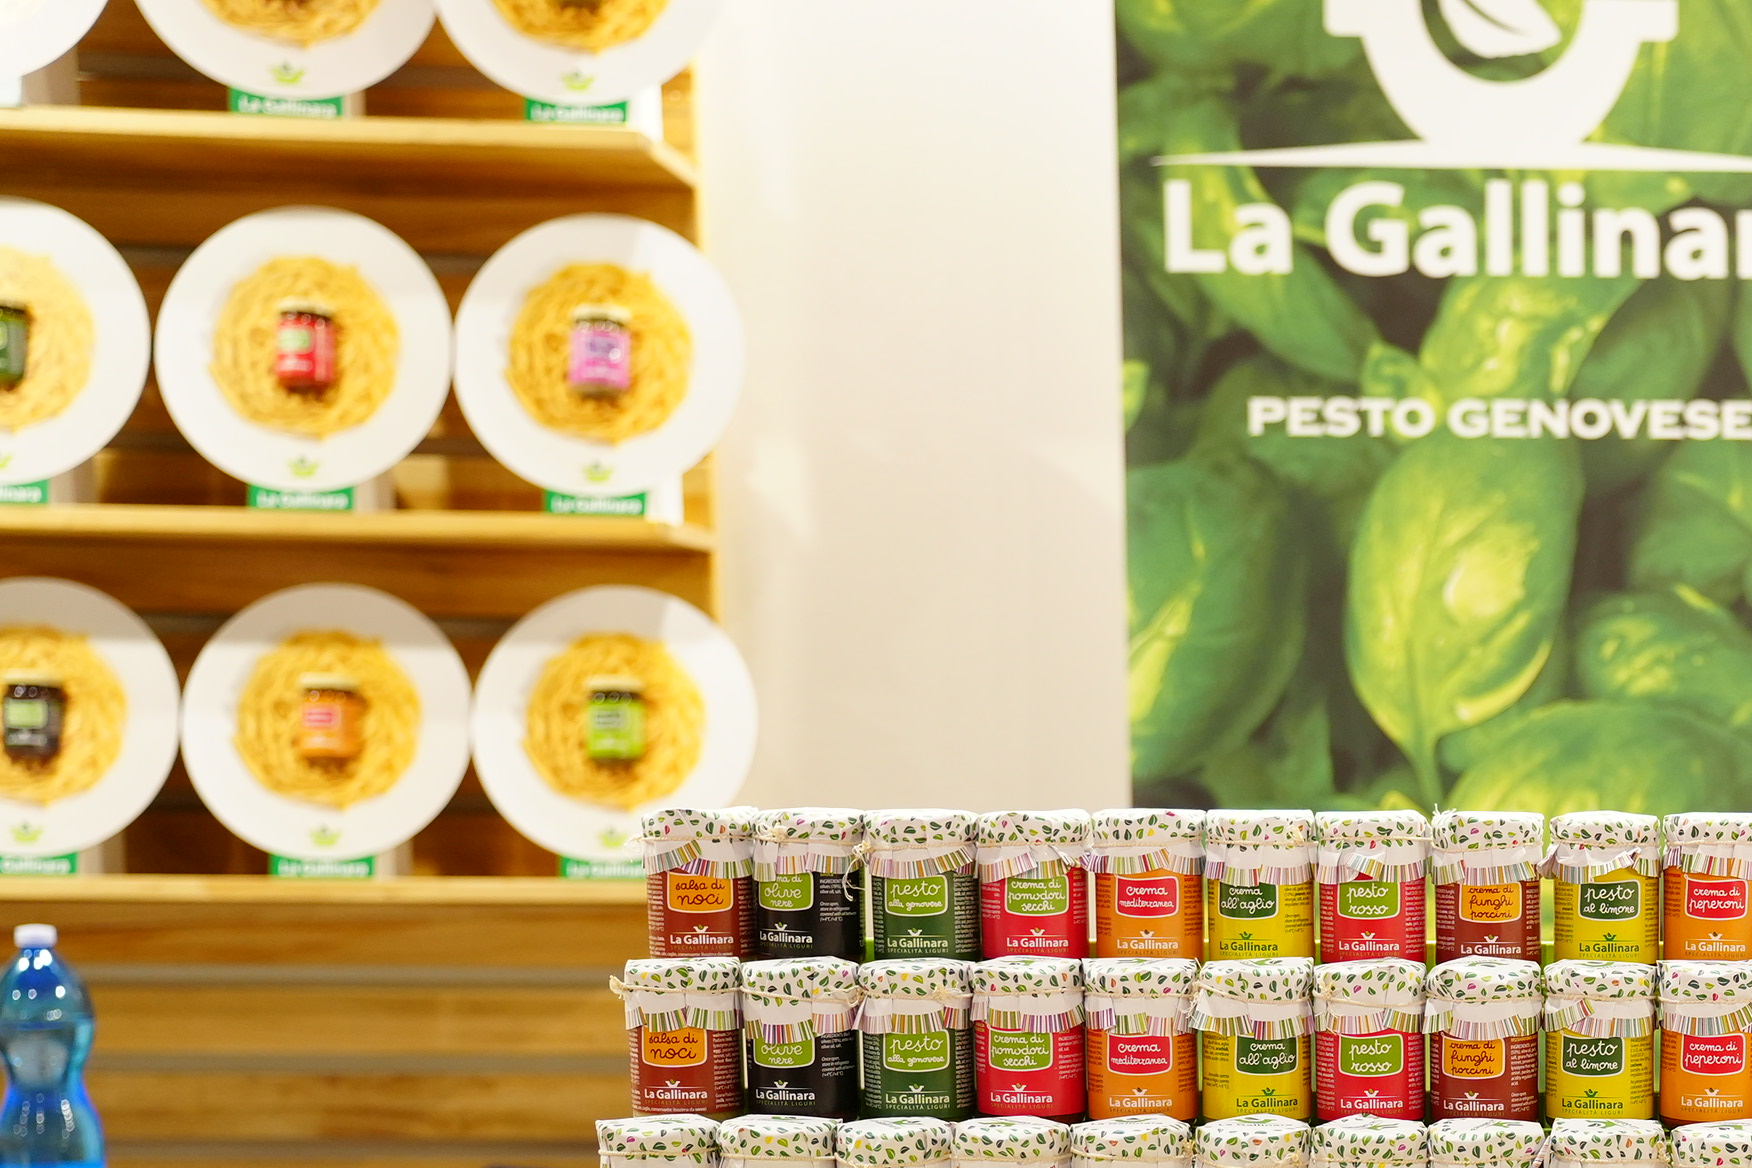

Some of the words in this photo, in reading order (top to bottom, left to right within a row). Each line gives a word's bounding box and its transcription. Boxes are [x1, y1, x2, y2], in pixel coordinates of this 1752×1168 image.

[1162, 179, 1294, 276] La
[1248, 395, 1436, 439] PESTO
[676, 881, 702, 892] salsa
[707, 879, 725, 892] di
[890, 881, 939, 898] pesto
[1126, 886, 1168, 896] crema
[1347, 884, 1389, 900] pesto
[1585, 884, 1635, 903] pesto
[678, 891, 724, 906] noci
[1120, 898, 1175, 909] mediterranea
[890, 900, 905, 909] alla
[907, 900, 943, 910] genovese
[1351, 902, 1389, 916] rosso
[1584, 903, 1595, 913] al
[1601, 902, 1635, 914] limone
[670, 935, 681, 945] La
[684, 934, 733, 945] Gallinara
[888, 938, 898, 948] La
[900, 938, 948, 948] Gallinara
[1116, 939, 1127, 948] La
[1129, 938, 1178, 949] Gallinara
[1339, 941, 1350, 951] La
[1352, 941, 1400, 952] Gallinara
[1579, 943, 1590, 952] La
[1592, 942, 1639, 953] Gallinara
[994, 1032, 1024, 1043] crema
[1030, 1031, 1045, 1044] di
[991, 1045, 1048, 1059] pomodori
[1690, 1044, 1721, 1052] crema
[1727, 1041, 1738, 1052] di
[1003, 1055, 1038, 1066] secchi
[1685, 1052, 1742, 1067] peperoni
[991, 1093, 1002, 1103] La
[1004, 1092, 1052, 1103] Gallinara
[1681, 1098, 1692, 1107] La
[1694, 1097, 1743, 1109] Gallinara
